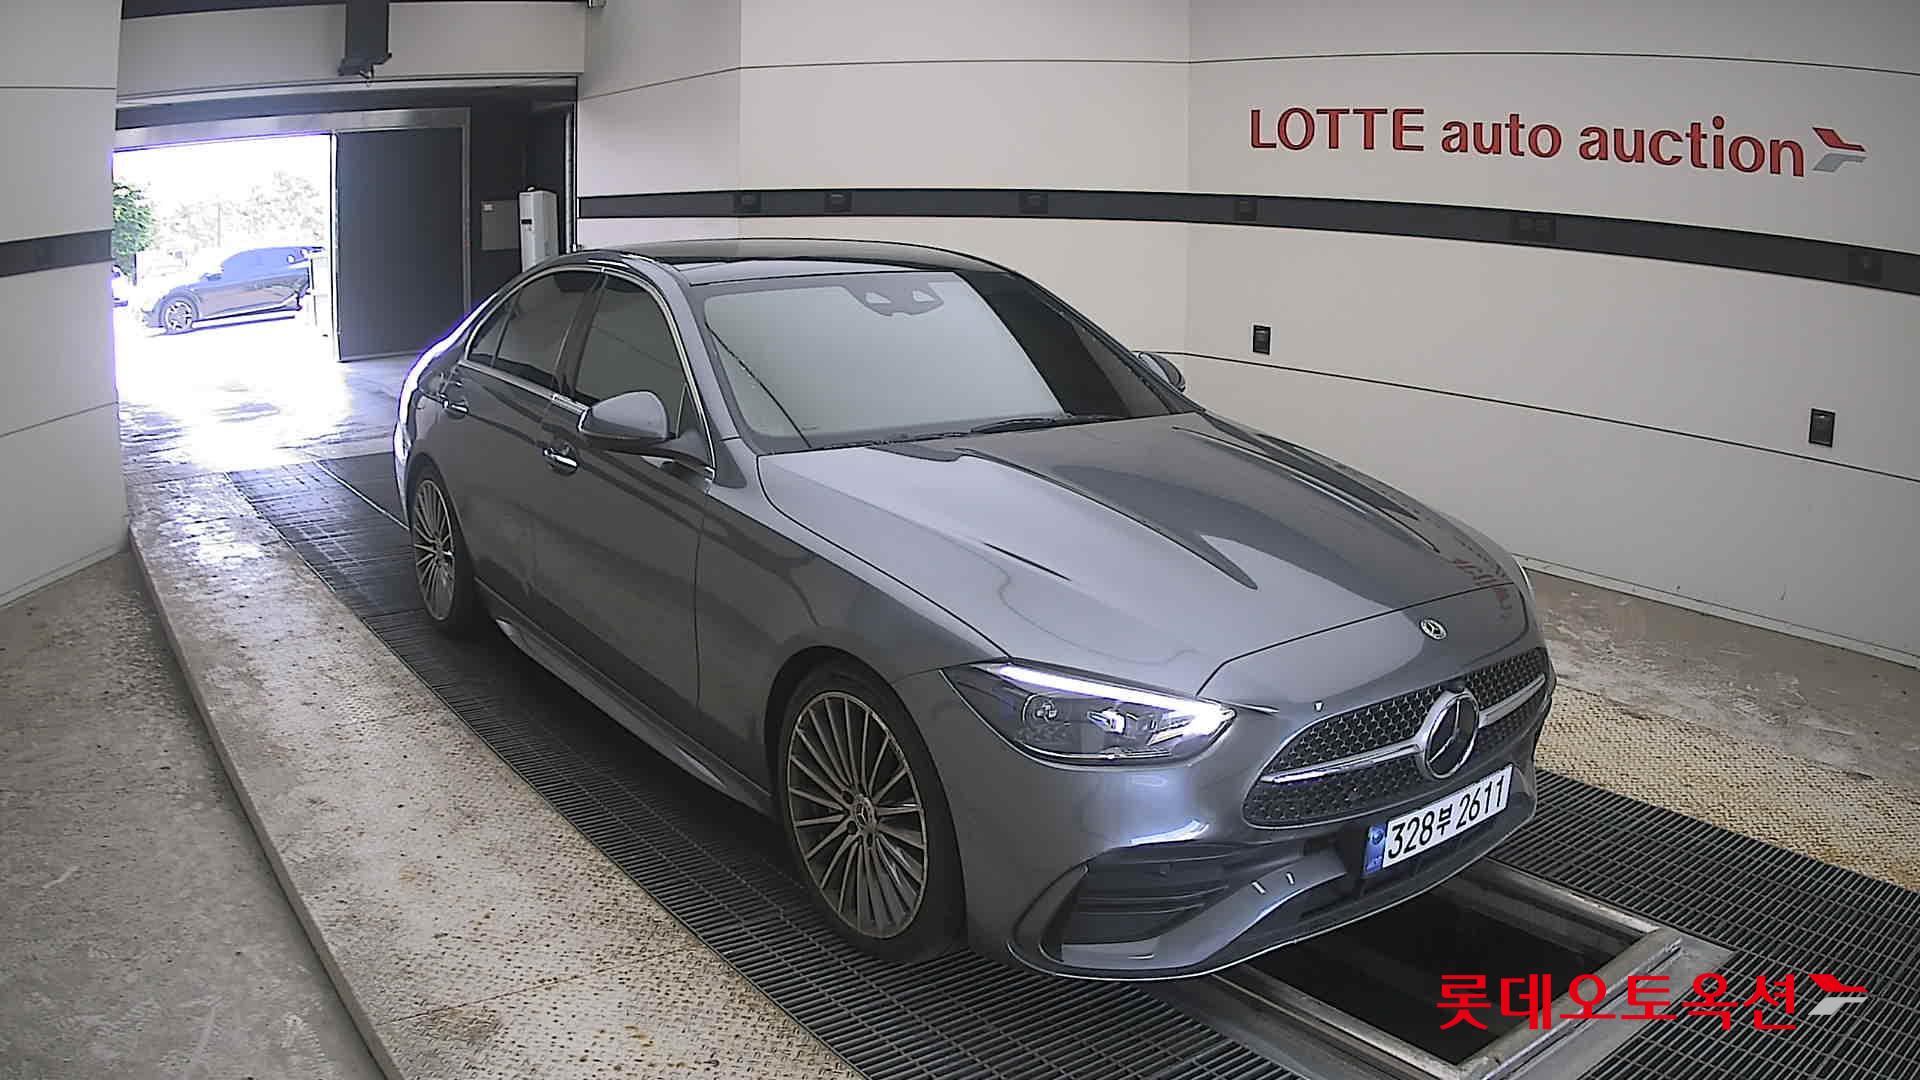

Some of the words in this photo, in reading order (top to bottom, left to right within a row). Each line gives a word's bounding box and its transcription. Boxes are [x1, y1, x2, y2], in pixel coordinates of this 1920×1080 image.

[1250, 107, 1424, 151] LOTTE
[1441, 113, 1562, 158] auto
[1578, 115, 1806, 178] auction
[1388, 803, 1453, 859] 328부
[1456, 775, 1505, 830] 2611
